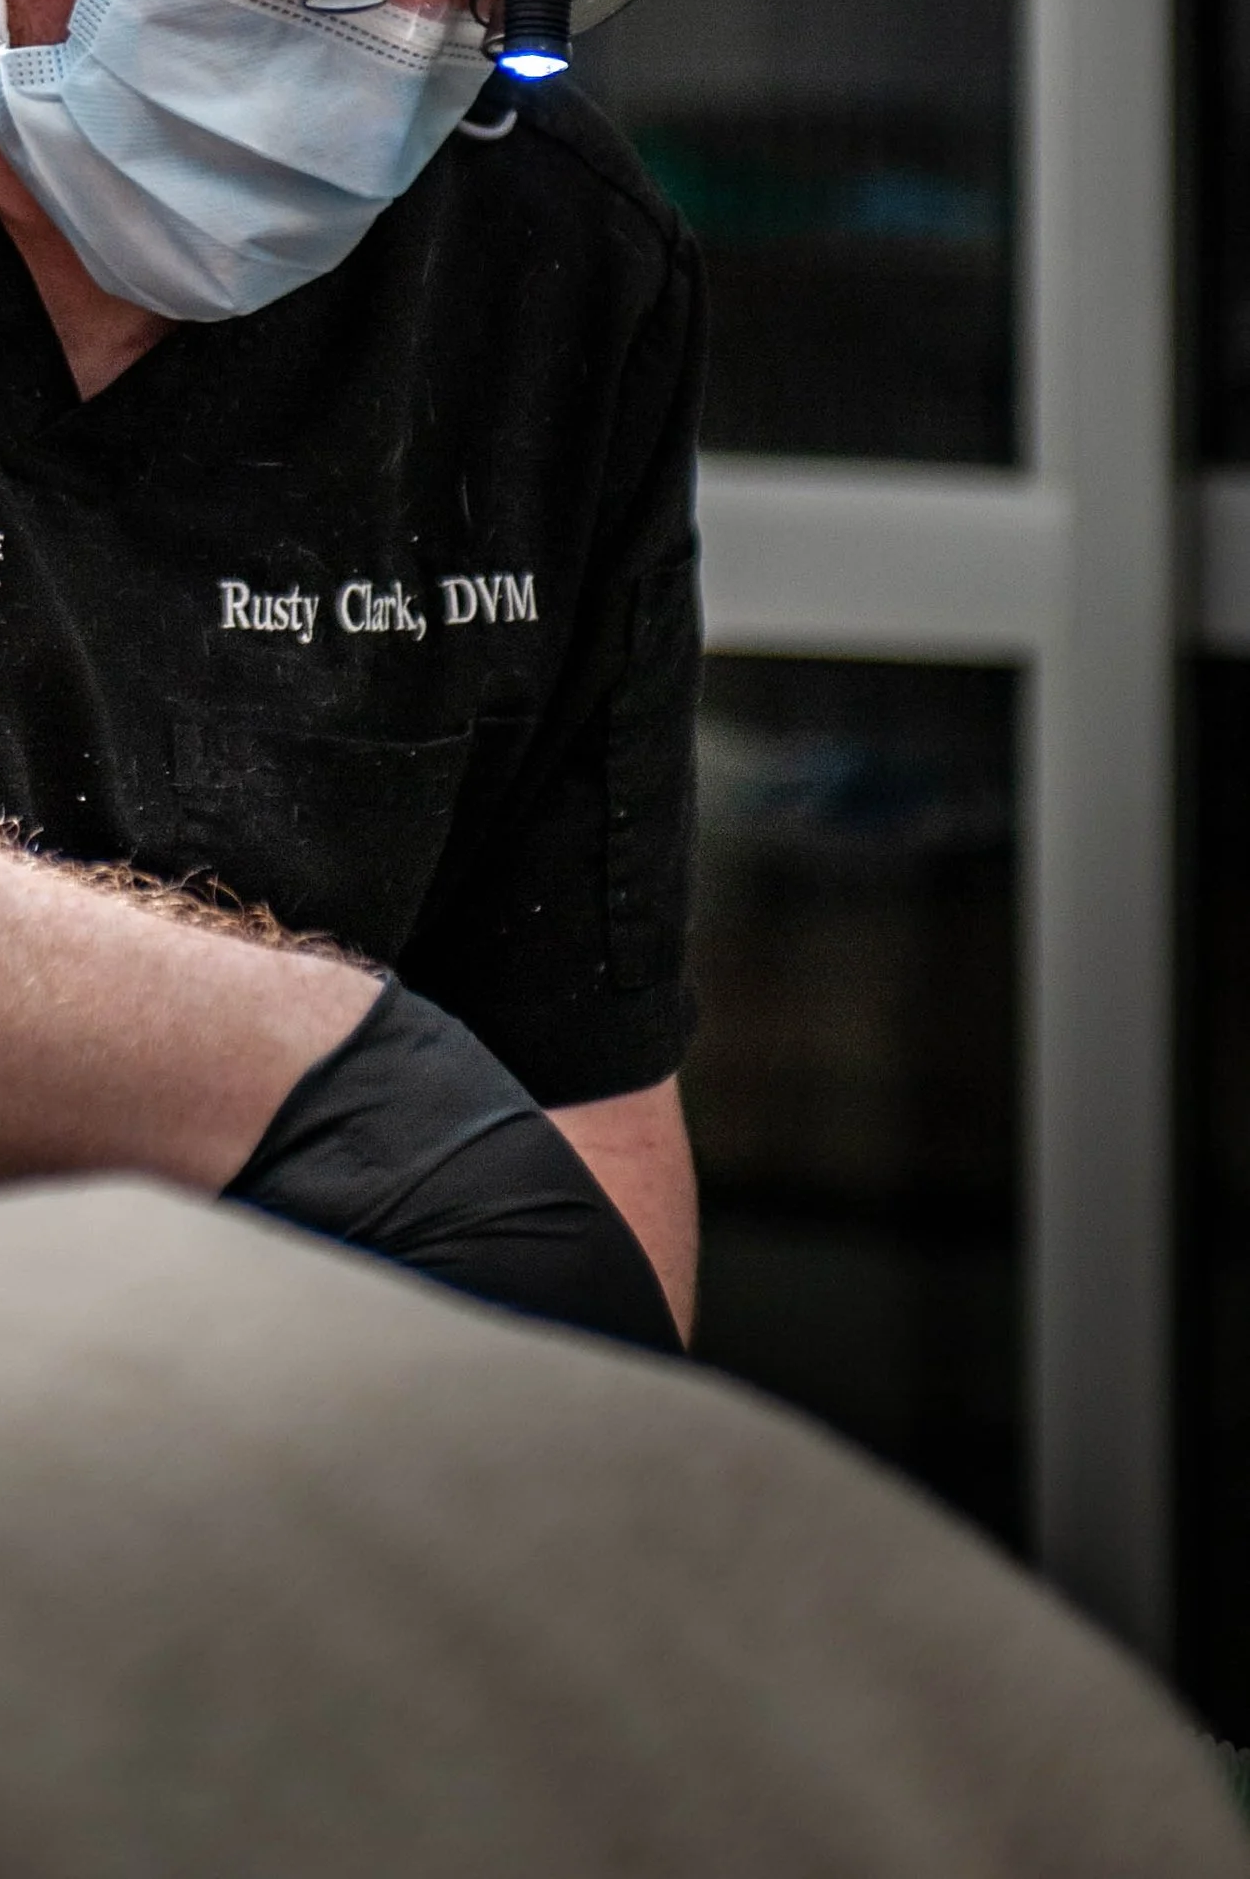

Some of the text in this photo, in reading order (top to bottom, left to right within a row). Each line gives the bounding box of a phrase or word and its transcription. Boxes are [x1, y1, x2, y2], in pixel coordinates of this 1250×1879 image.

[221, 574, 539, 644] Rusty Clark, DVM
